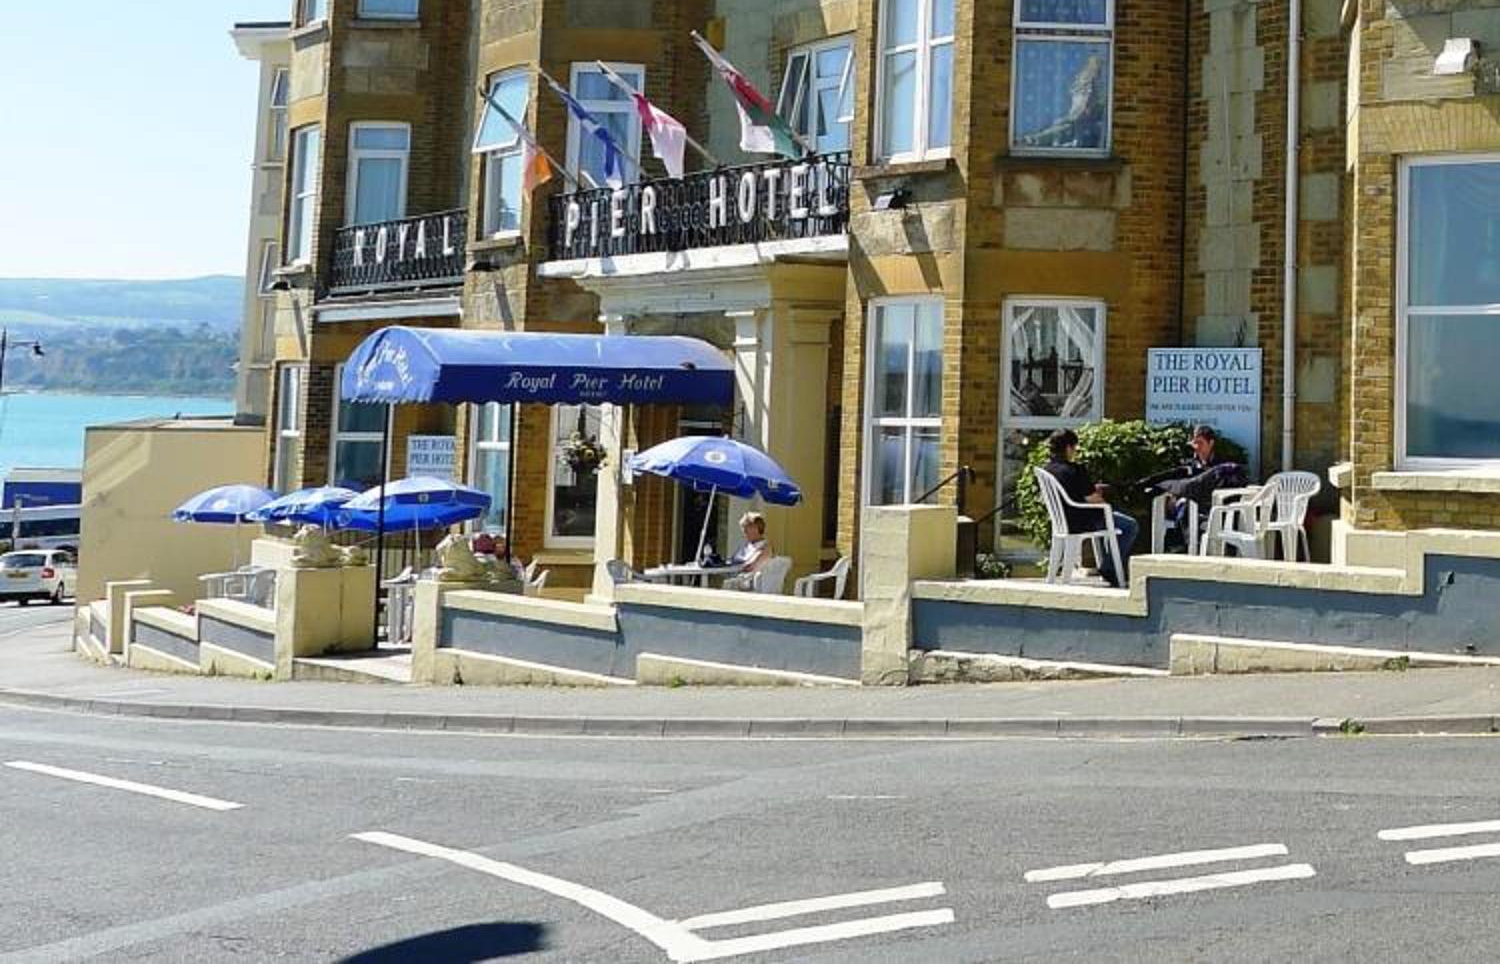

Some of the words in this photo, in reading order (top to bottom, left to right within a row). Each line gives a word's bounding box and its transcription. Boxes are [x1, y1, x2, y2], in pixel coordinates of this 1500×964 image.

[353, 217, 454, 267] ROYAL
[564, 185, 657, 248] PIER
[709, 161, 839, 229] HOTEL
[1154, 353, 1188, 371] THE
[1193, 353, 1255, 371] ROYAL
[505, 371, 557, 393] Royal
[569, 373, 609, 389] Pier
[617, 373, 664, 389] Hotel
[1153, 376, 1190, 394] PIER
[1195, 377, 1255, 394] HOTEL
